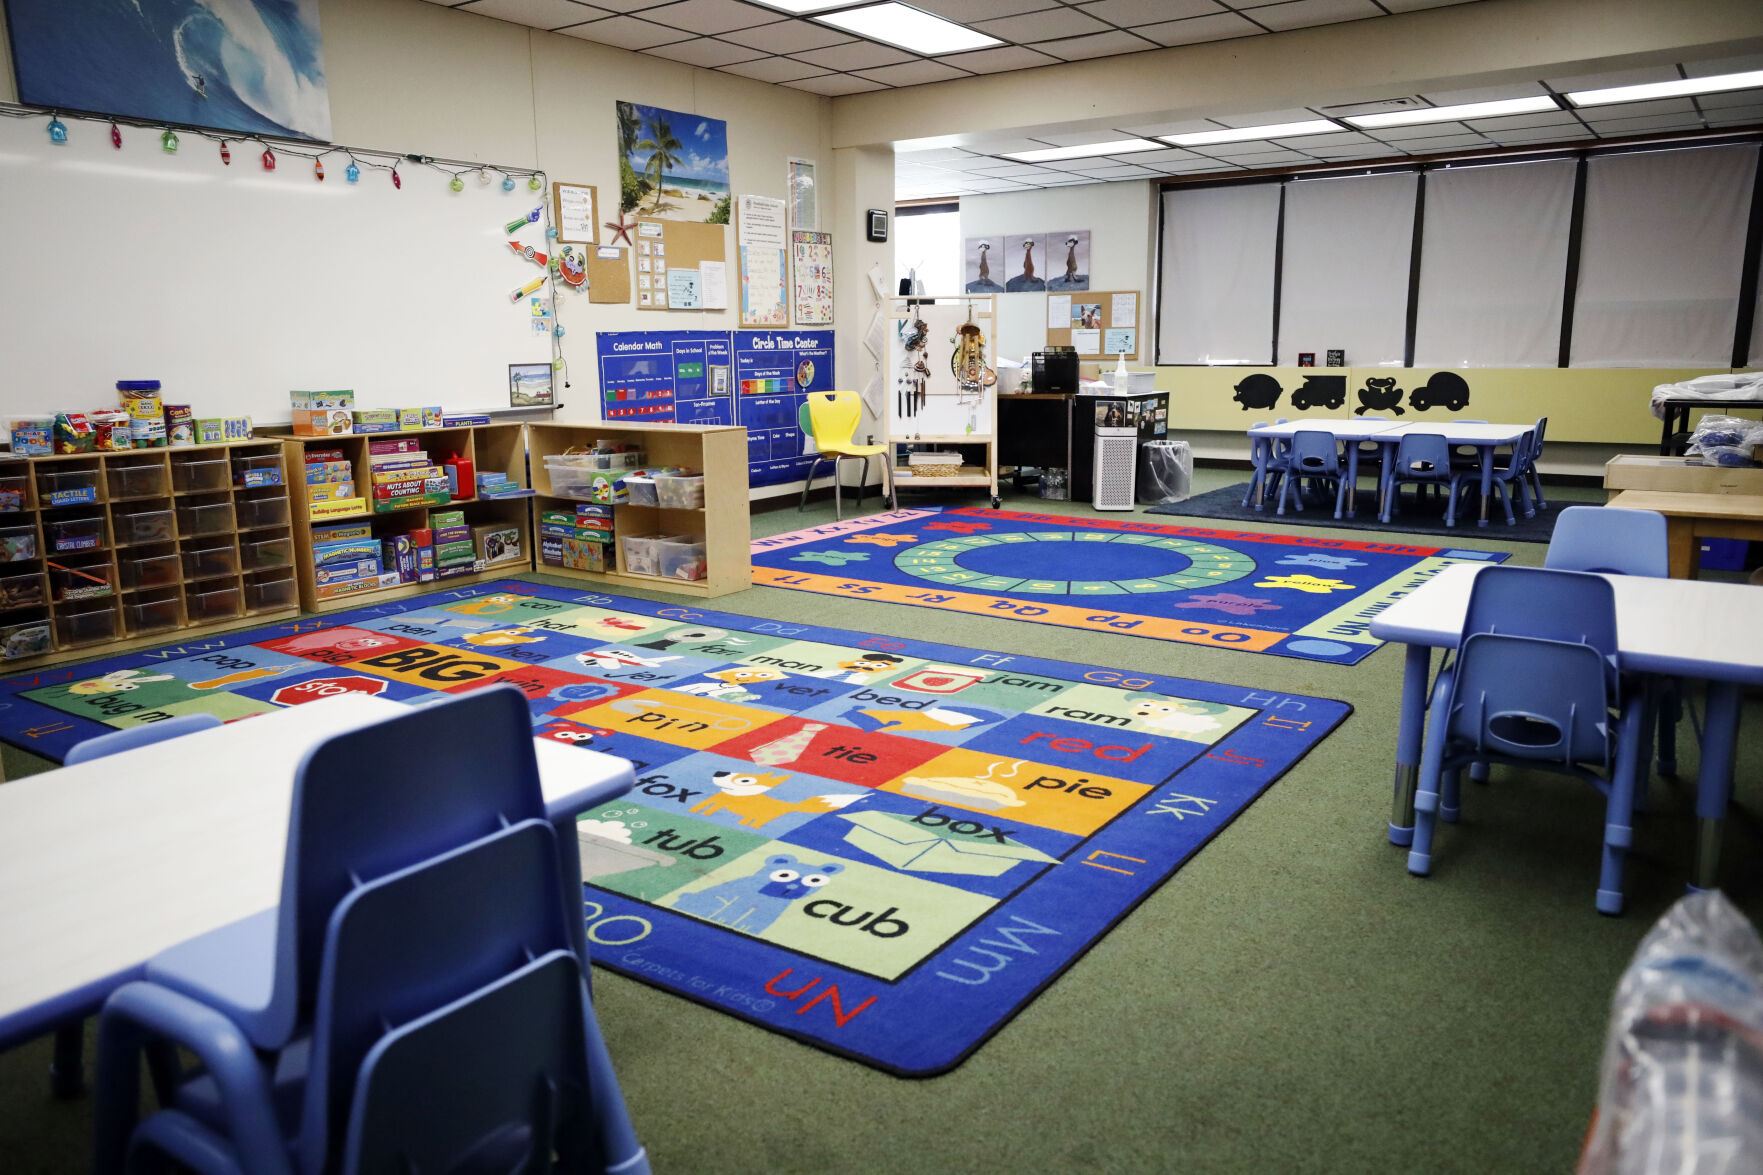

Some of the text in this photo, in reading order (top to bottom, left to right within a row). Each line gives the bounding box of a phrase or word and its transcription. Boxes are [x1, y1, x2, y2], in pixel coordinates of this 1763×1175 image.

[613, 341, 663, 351] Calendar Math
[752, 335, 818, 350] Circle Time Center
[386, 480, 422, 491] NUTS ABOUT
[390, 487, 420, 497] COUNTING
[52, 489, 88, 500] TACTILE
[836, 583, 883, 594] Ss
[519, 600, 564, 612] cat
[905, 593, 957, 604] Rr
[378, 623, 438, 637] pen
[528, 618, 579, 632] hat
[1085, 615, 1145, 629] Pp
[300, 649, 358, 664] pig
[495, 646, 551, 662] hen
[572, 594, 613, 606] Bb
[657, 608, 703, 620] Cc
[751, 622, 809, 636] Dd
[858, 637, 906, 650] Ee
[970, 653, 1016, 666] Ff
[1083, 670, 1155, 690] Gg
[1240, 692, 1307, 711] Hh
[689, 644, 745, 656] fan
[190, 653, 257, 670] pop
[359, 648, 501, 682] BIG
[750, 655, 823, 672] man
[603, 671, 677, 682] jet
[975, 674, 1065, 692] jam
[773, 682, 832, 698] vet
[84, 692, 146, 715] bug
[847, 689, 939, 710] bed
[624, 711, 710, 733] pin
[1045, 705, 1132, 727] ram
[822, 745, 879, 764] tie
[1019, 731, 1155, 763] red
[633, 775, 704, 804] fox
[1022, 775, 1113, 800] pie
[1145, 792, 1218, 820] Kk
[910, 806, 1018, 844] box
[640, 828, 725, 860] tub
[802, 898, 910, 939] cub
[935, 915, 1062, 986] Mm
[685, 975, 714, 991] for
[763, 967, 879, 1029] Nn
